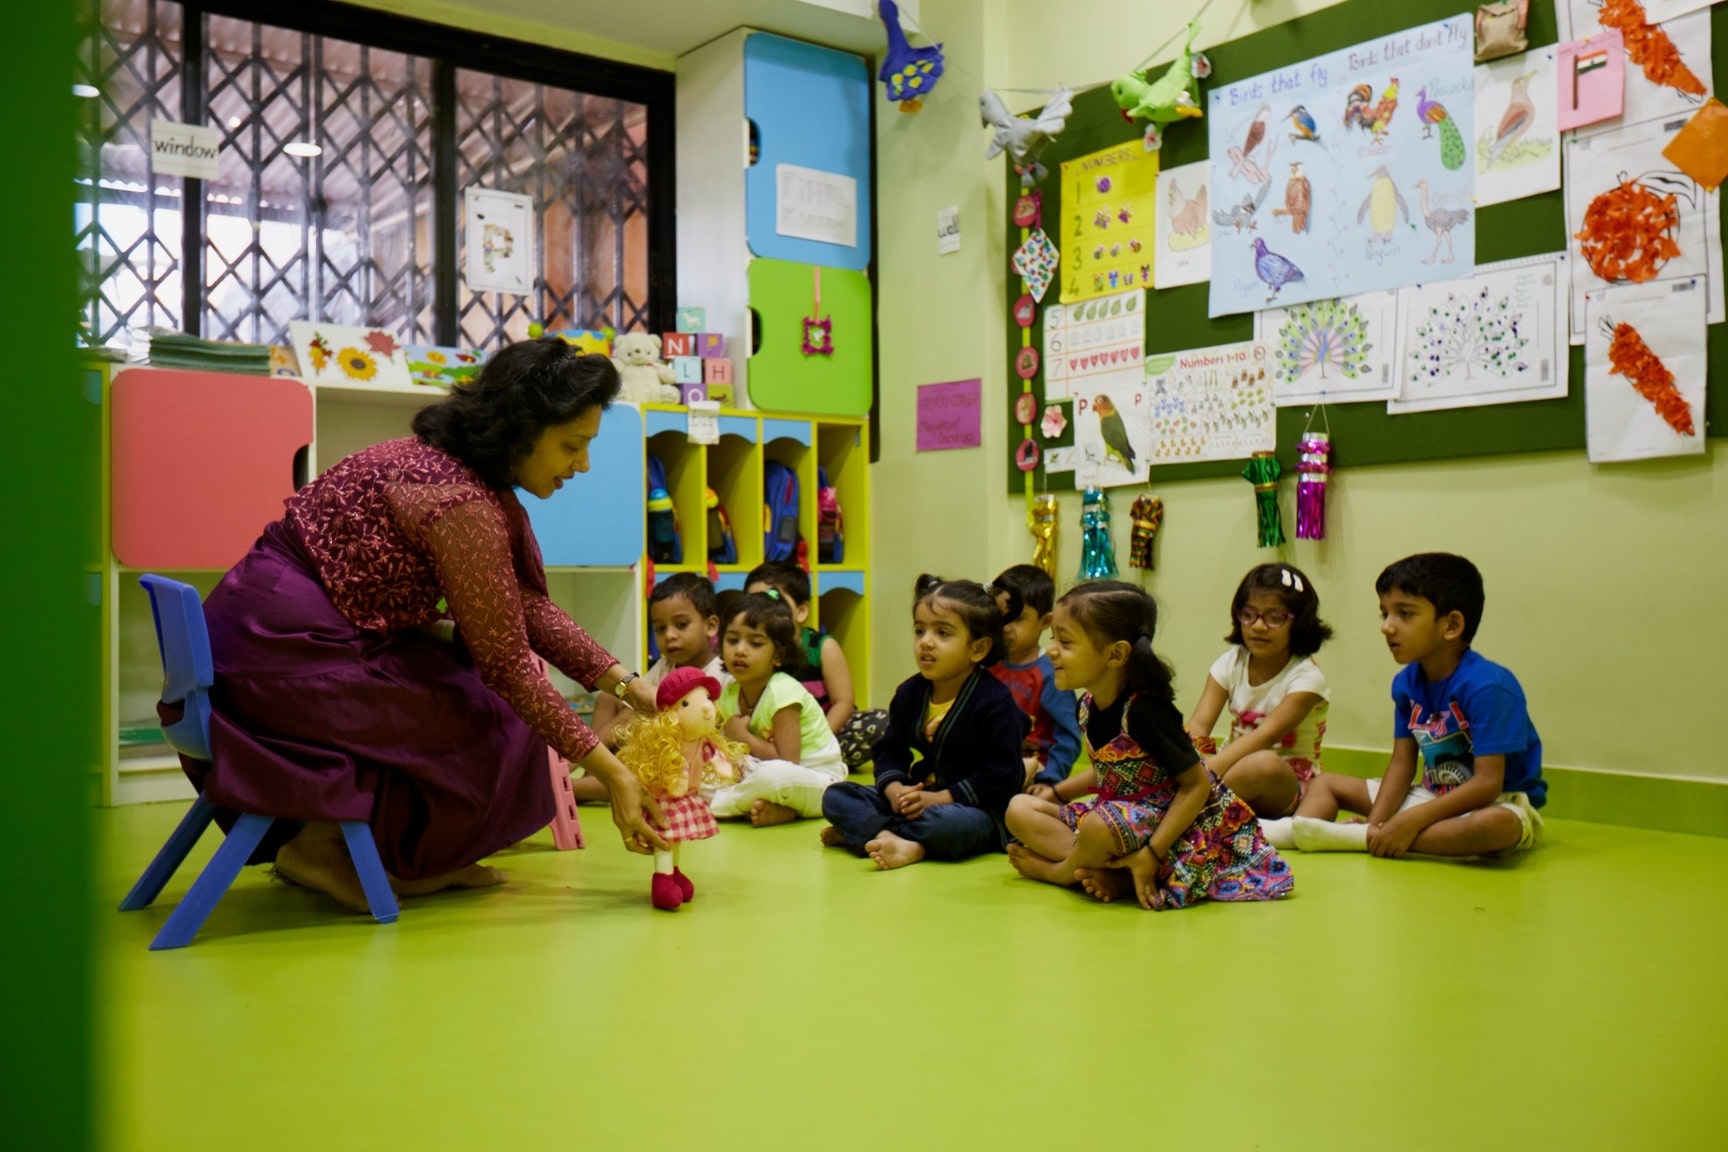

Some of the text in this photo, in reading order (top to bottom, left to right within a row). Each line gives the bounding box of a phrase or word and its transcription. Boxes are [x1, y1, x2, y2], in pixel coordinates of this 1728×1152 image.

[1384, 39, 1410, 61] that
[1271, 68, 1301, 94] that
[1309, 63, 1328, 88] fly
[154, 135, 217, 160] window
[1073, 214, 1083, 238] 2
[1072, 246, 1083, 271] 3
[1067, 277, 1080, 297] 4
[1050, 308, 1061, 329] 5
[667, 338, 683, 354] N
[1050, 332, 1062, 352] 6
[1051, 357, 1063, 377] 7
[1227, 352, 1246, 362] 1-10
[683, 363, 691, 378] L
[712, 365, 725, 380] H
